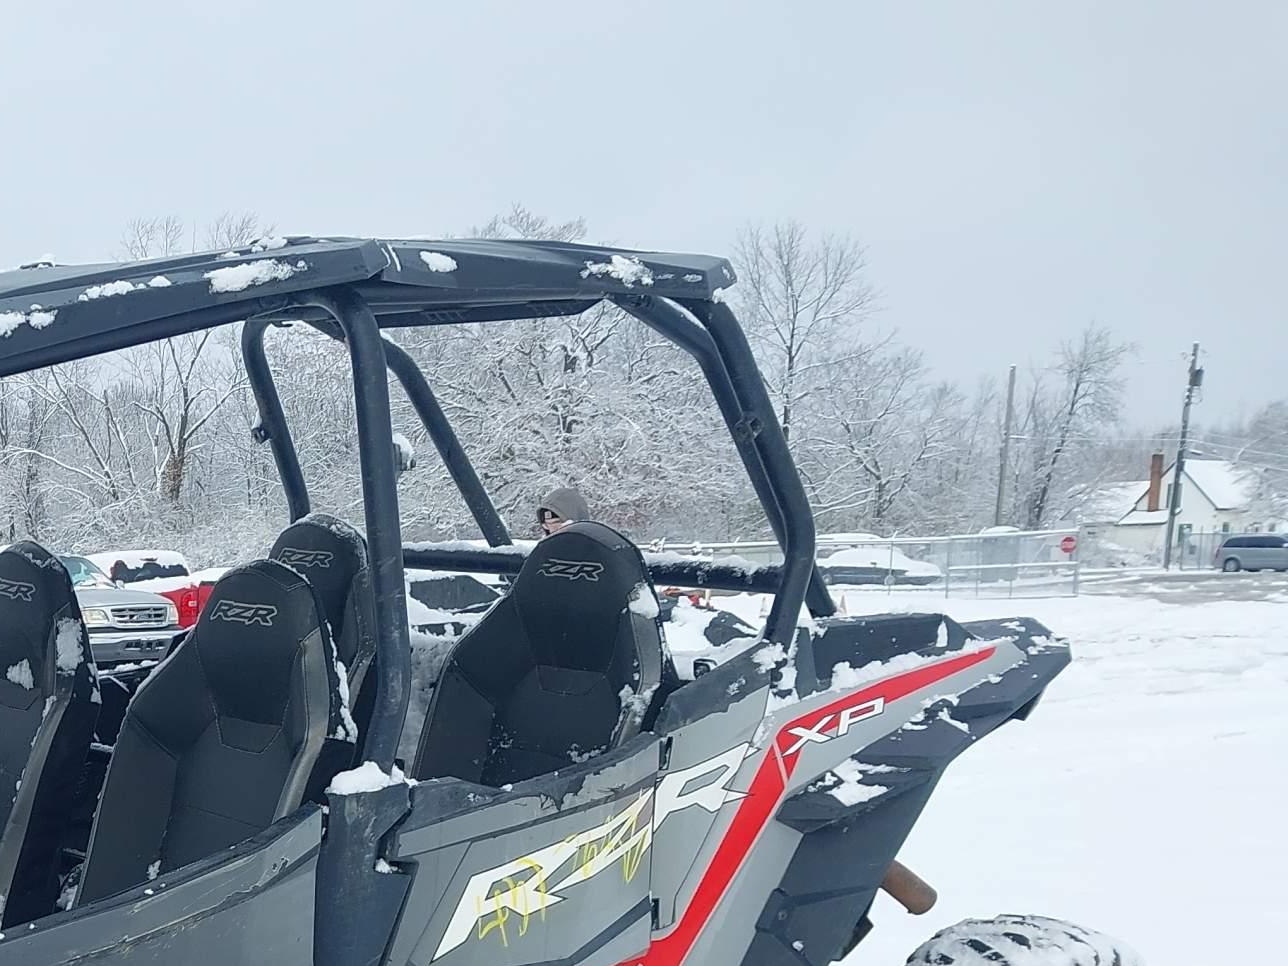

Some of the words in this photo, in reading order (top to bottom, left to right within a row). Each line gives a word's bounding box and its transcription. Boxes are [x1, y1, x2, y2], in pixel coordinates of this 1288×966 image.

[277, 548, 334, 568] RZR
[534, 558, 604, 581] RZR
[211, 600, 277, 626] RZR
[781, 697, 885, 757] XP
[431, 741, 760, 963] RZR
